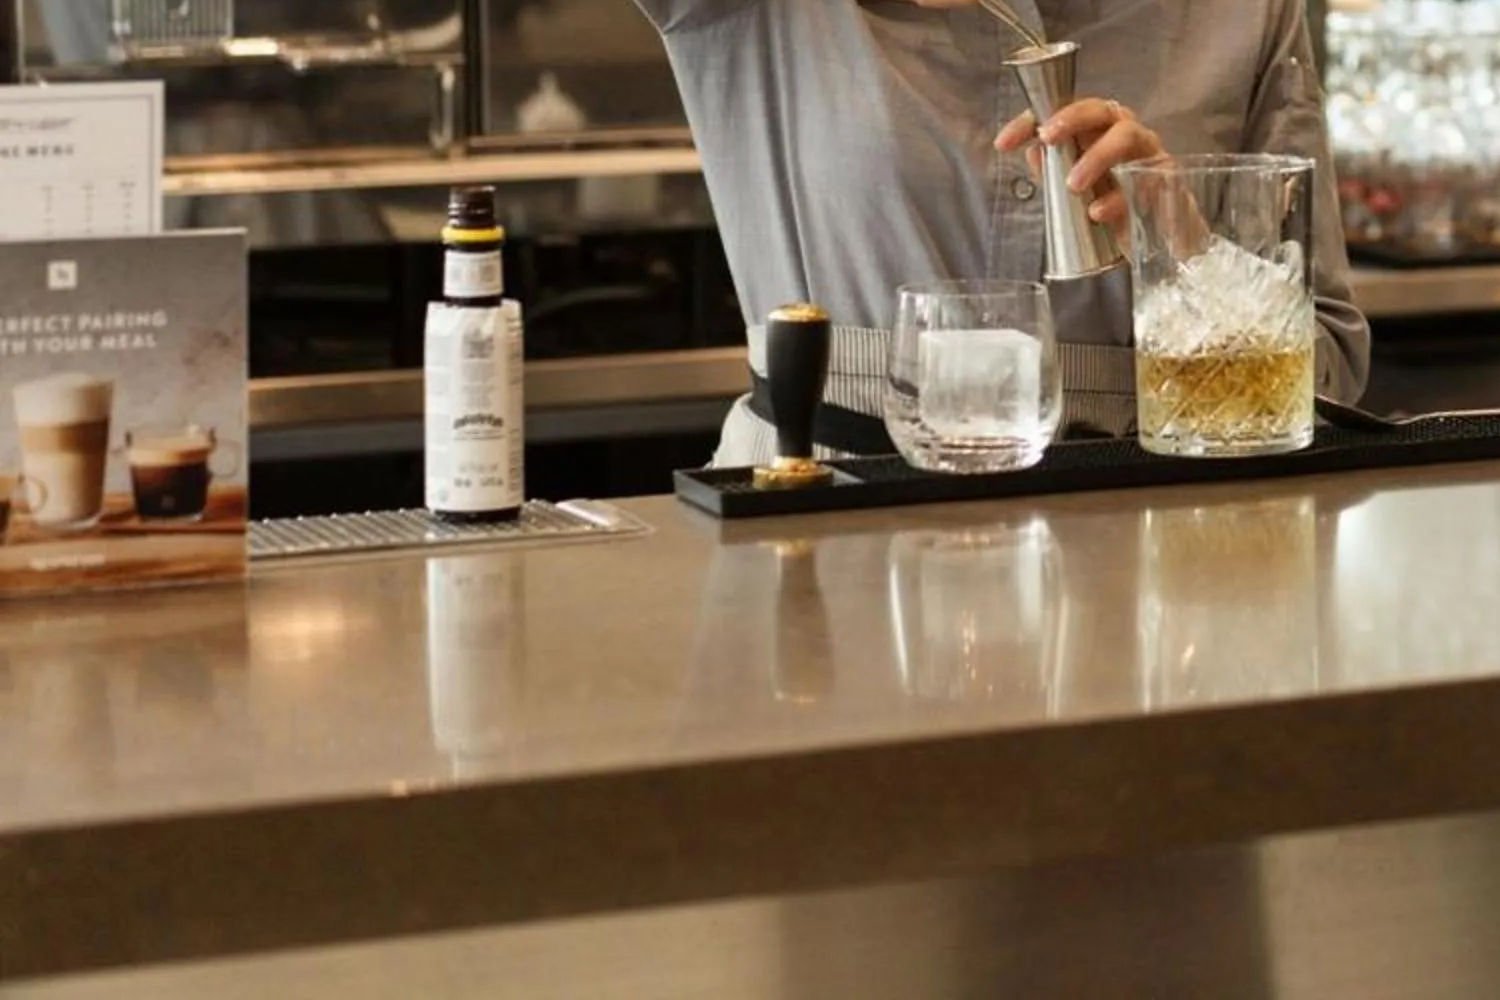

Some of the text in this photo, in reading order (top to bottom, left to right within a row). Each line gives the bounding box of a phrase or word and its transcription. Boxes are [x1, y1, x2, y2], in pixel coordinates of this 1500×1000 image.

[78, 309, 167, 331] PAIRING
[33, 335, 92, 352] YOUR
[101, 332, 156, 349] MEAL
